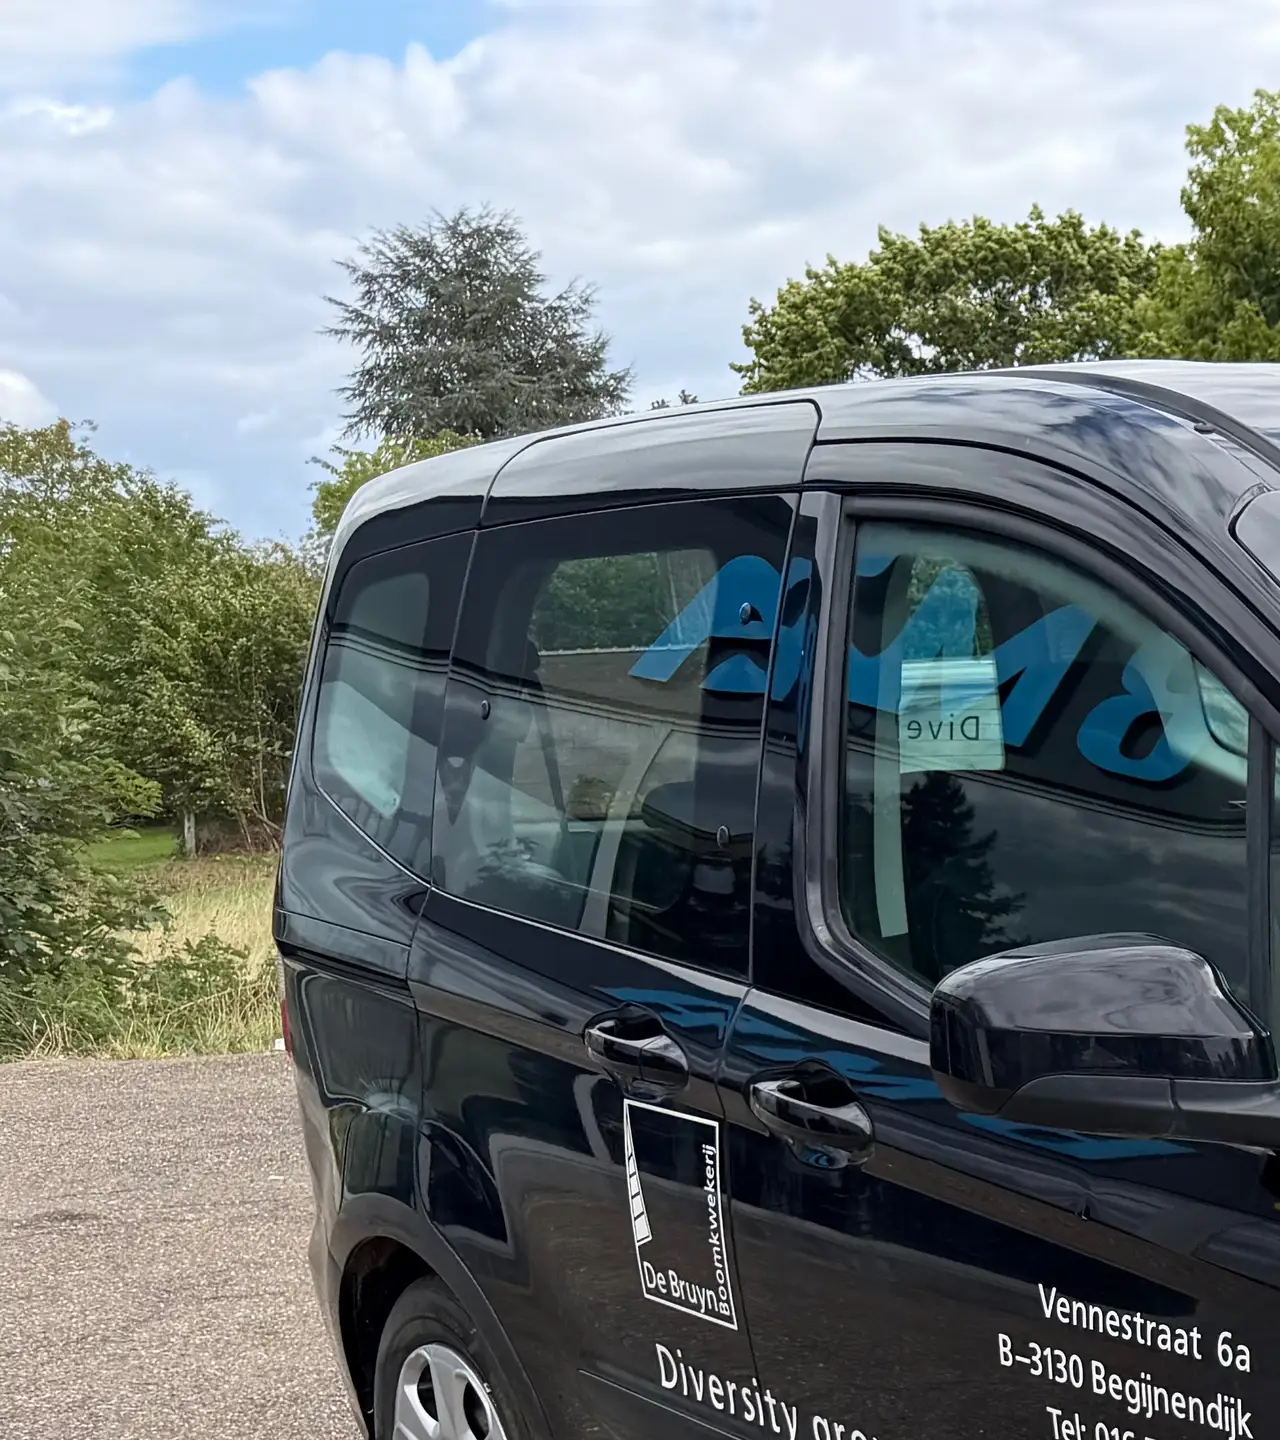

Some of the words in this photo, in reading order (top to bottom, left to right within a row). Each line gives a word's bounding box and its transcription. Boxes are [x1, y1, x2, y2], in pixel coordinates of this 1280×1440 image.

[702, 1143, 730, 1315] Boomkwekerij
[643, 1260, 667, 1294] De
[668, 1269, 718, 1313] Bruyn
[1037, 1283, 1202, 1360] Vennestraat
[1217, 1331, 1251, 1373] 6a
